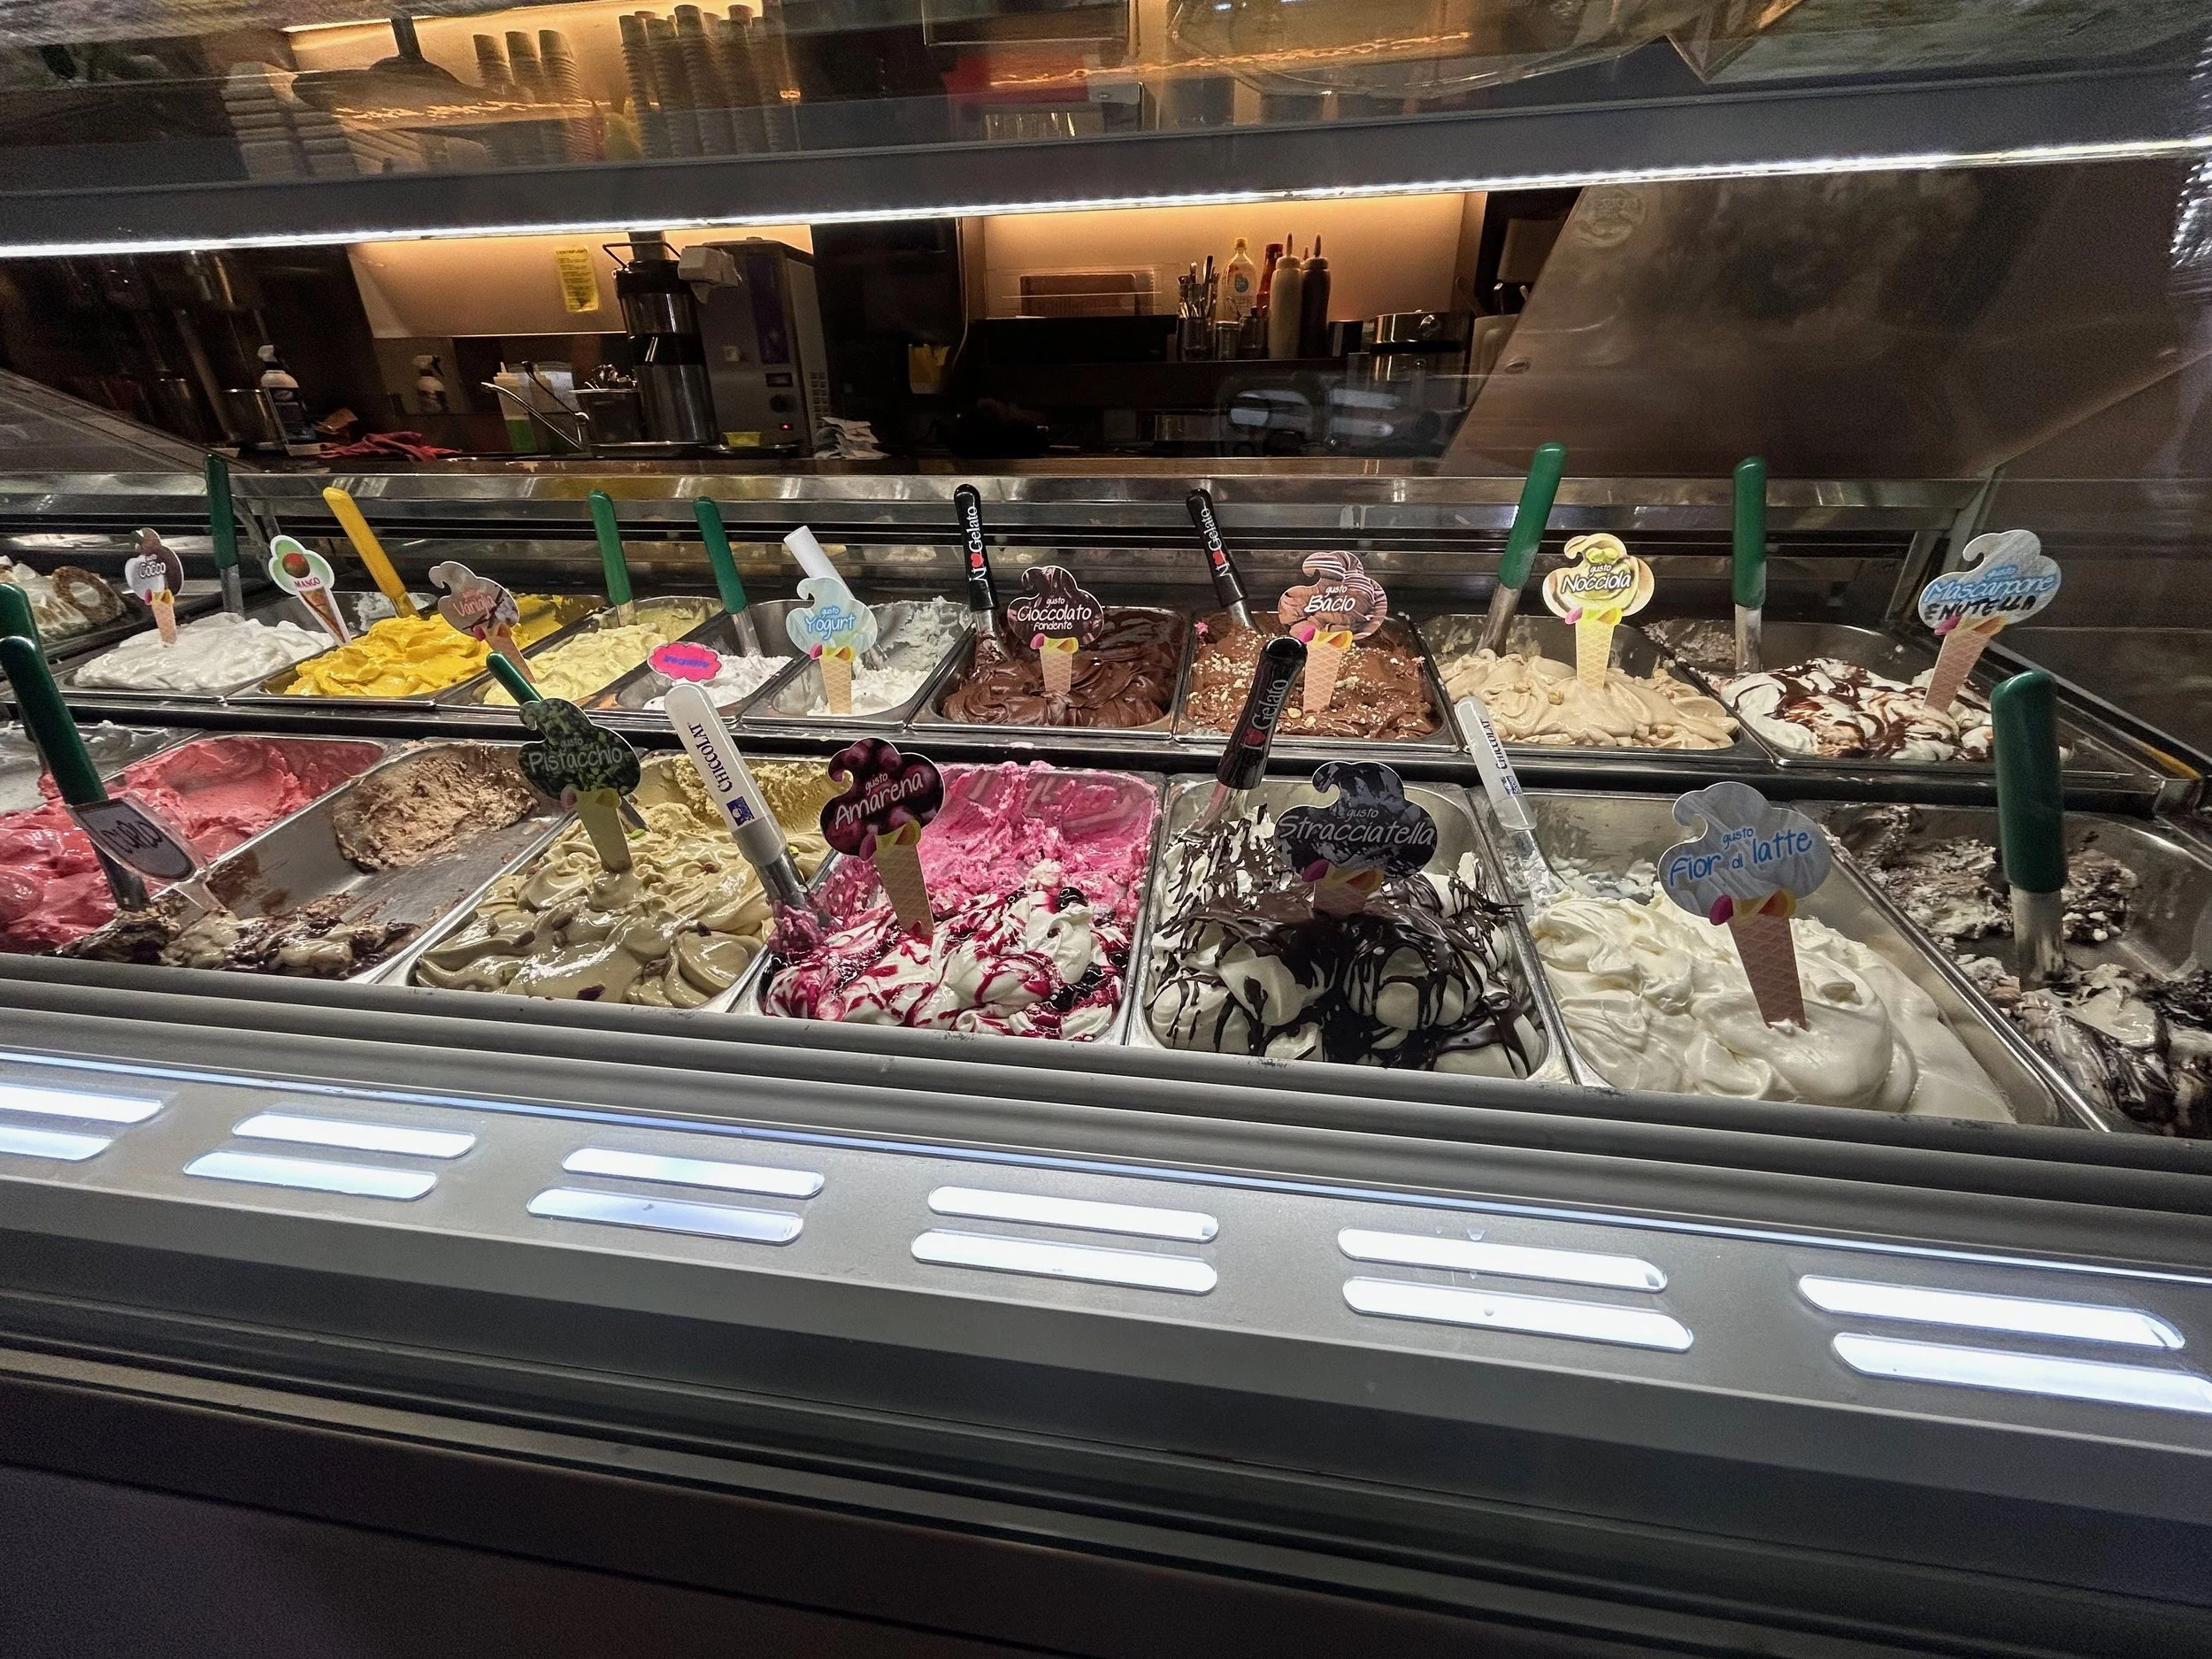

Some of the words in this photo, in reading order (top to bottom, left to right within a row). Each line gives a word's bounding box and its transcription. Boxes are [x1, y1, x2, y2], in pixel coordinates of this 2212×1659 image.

[965, 506, 983, 553] Gelato
[1201, 508, 1222, 551] Gelato
[1589, 564, 1612, 577] gusto
[293, 577, 321, 588] MANGO
[1325, 585, 1348, 597] gusto
[1561, 571, 1632, 594] Nocciola
[1924, 575, 2056, 603] Mascarpone
[821, 606, 840, 618] gusto
[1017, 603, 1092, 622] Cioccolato
[1046, 596, 1065, 609] gusto
[1303, 595, 1356, 613] Bacio
[1938, 595, 2037, 621] NUTELLA
[805, 614, 856, 640] Yogurt
[1251, 679, 1289, 731] Gelato
[561, 736, 583, 752] gusto
[528, 744, 623, 772] Pistacchio
[687, 722, 733, 793] CHICCOLAT
[865, 772, 888, 795] gusto
[834, 772, 924, 830] Amarena
[1344, 807, 1379, 823] gusto
[1278, 815, 1436, 846] Stracciatella
[1722, 826, 1754, 849] gusto
[1669, 854, 1722, 887] Fior
[1732, 853, 1743, 869] di
[1752, 828, 1813, 864] latte
